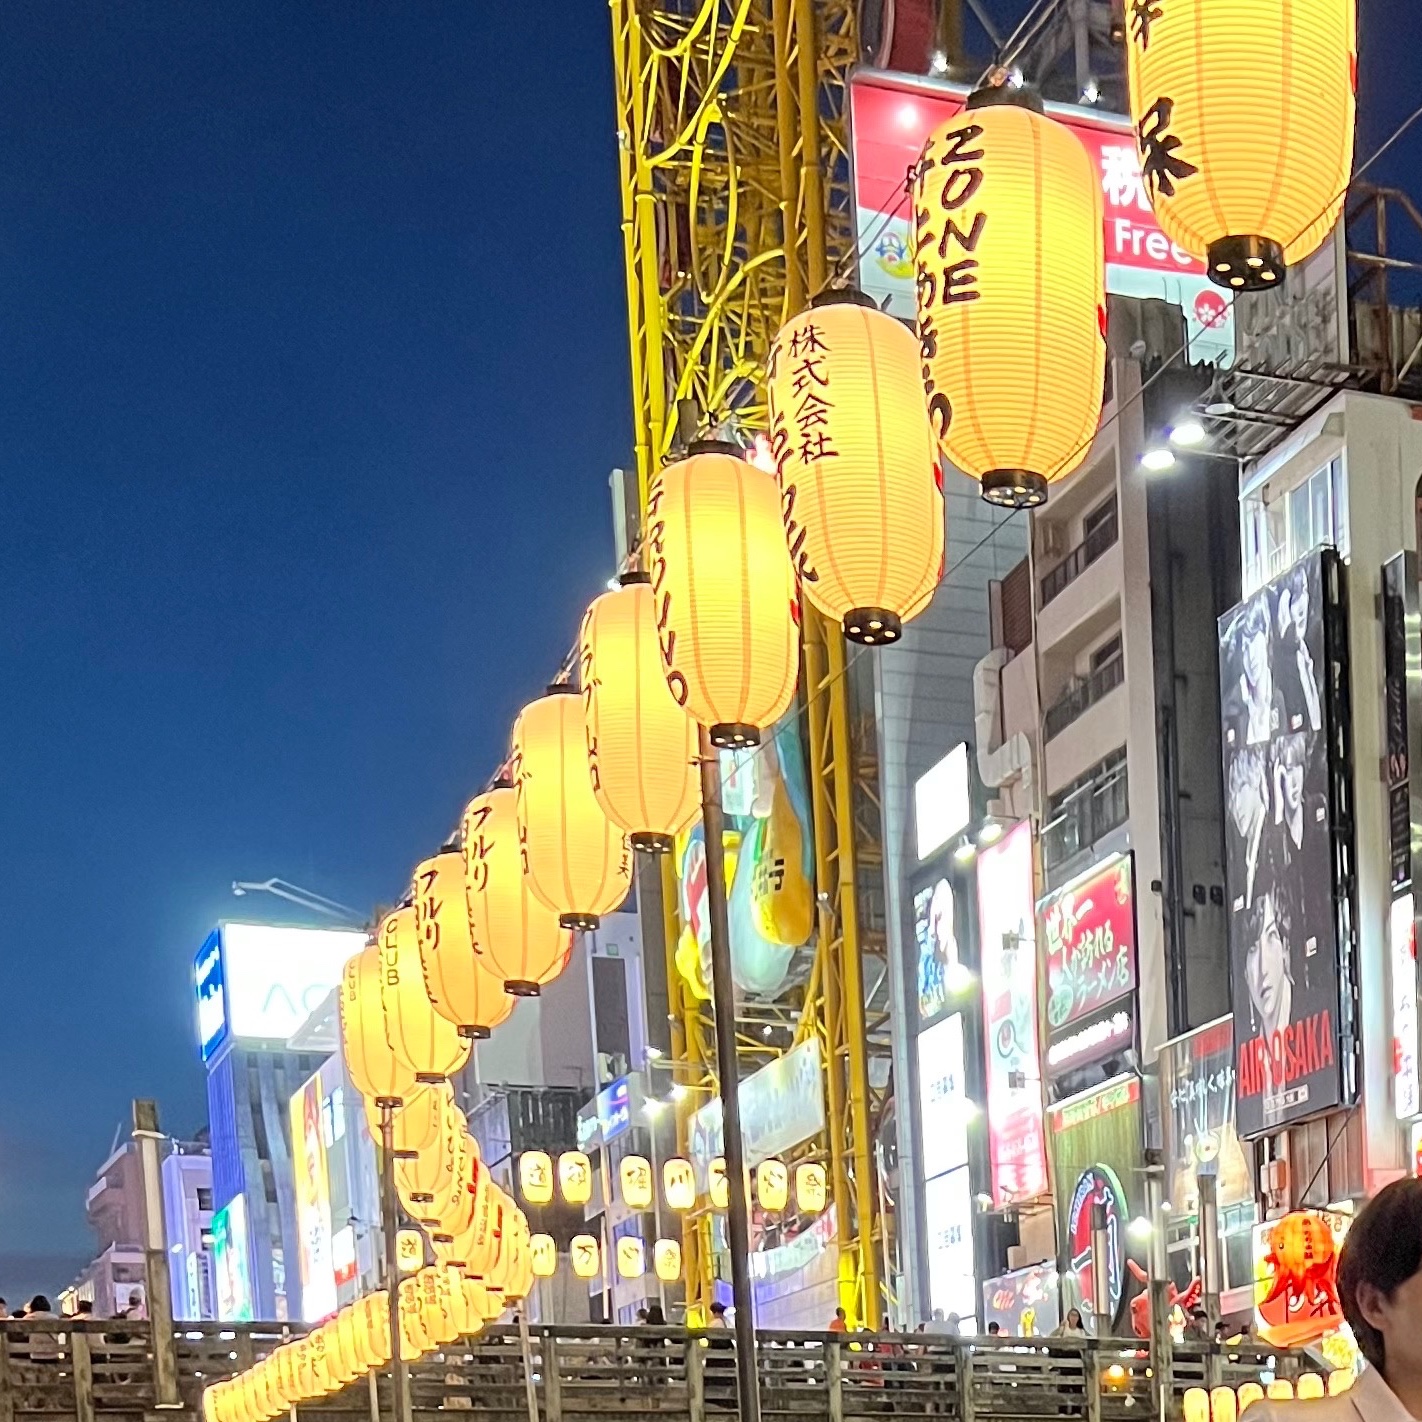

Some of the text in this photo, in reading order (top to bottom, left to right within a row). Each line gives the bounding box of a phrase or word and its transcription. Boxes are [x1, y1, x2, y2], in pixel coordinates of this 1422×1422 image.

[939, 124, 987, 305] ZONE
[1114, 217, 1193, 265] Free
[789, 324, 840, 466] 株式会社
[472, 805, 496, 892] フルリ
[420, 868, 444, 950] フルリ
[385, 917, 400, 986] CLUB
[1271, 1008, 1334, 1087] OSAKA
